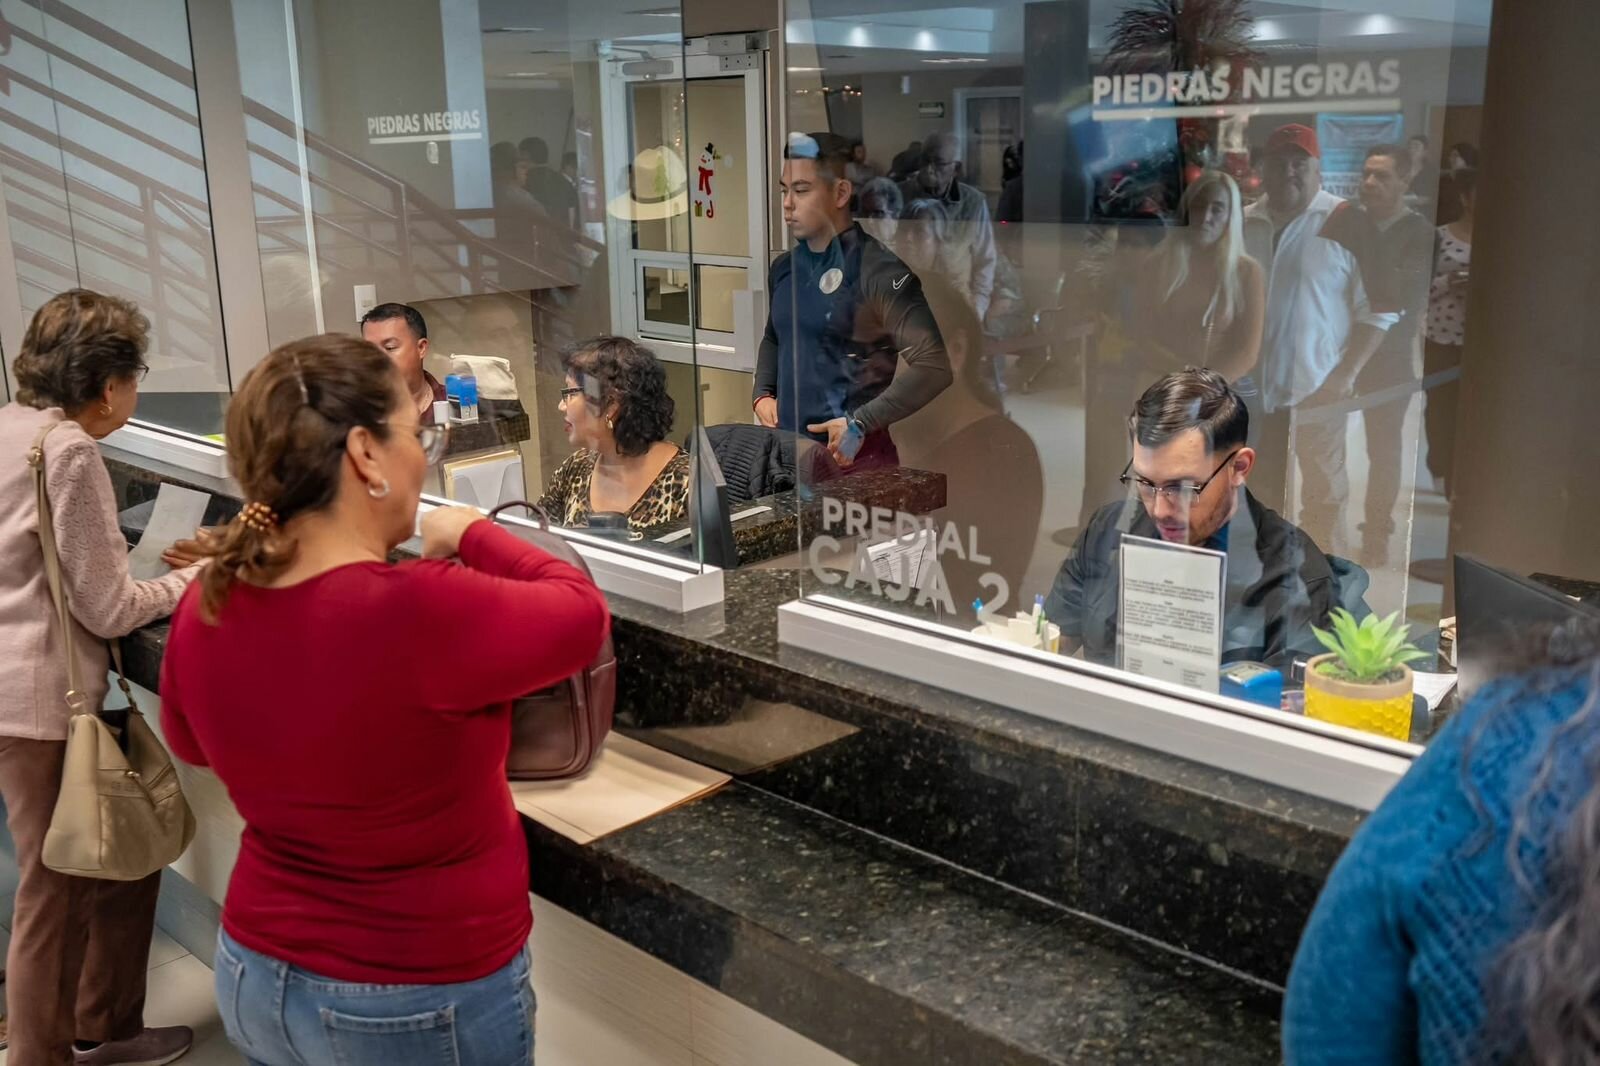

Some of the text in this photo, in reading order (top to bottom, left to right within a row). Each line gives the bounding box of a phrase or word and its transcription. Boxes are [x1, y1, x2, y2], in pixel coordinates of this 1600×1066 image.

[1093, 59, 1400, 105] PIEDRAS NEGRAS
[367, 109, 481, 135] PIEDRAS NEGRAS
[822, 496, 992, 565] PREDIAL
[808, 535, 957, 616] CAJA
[976, 571, 1010, 629] 2
